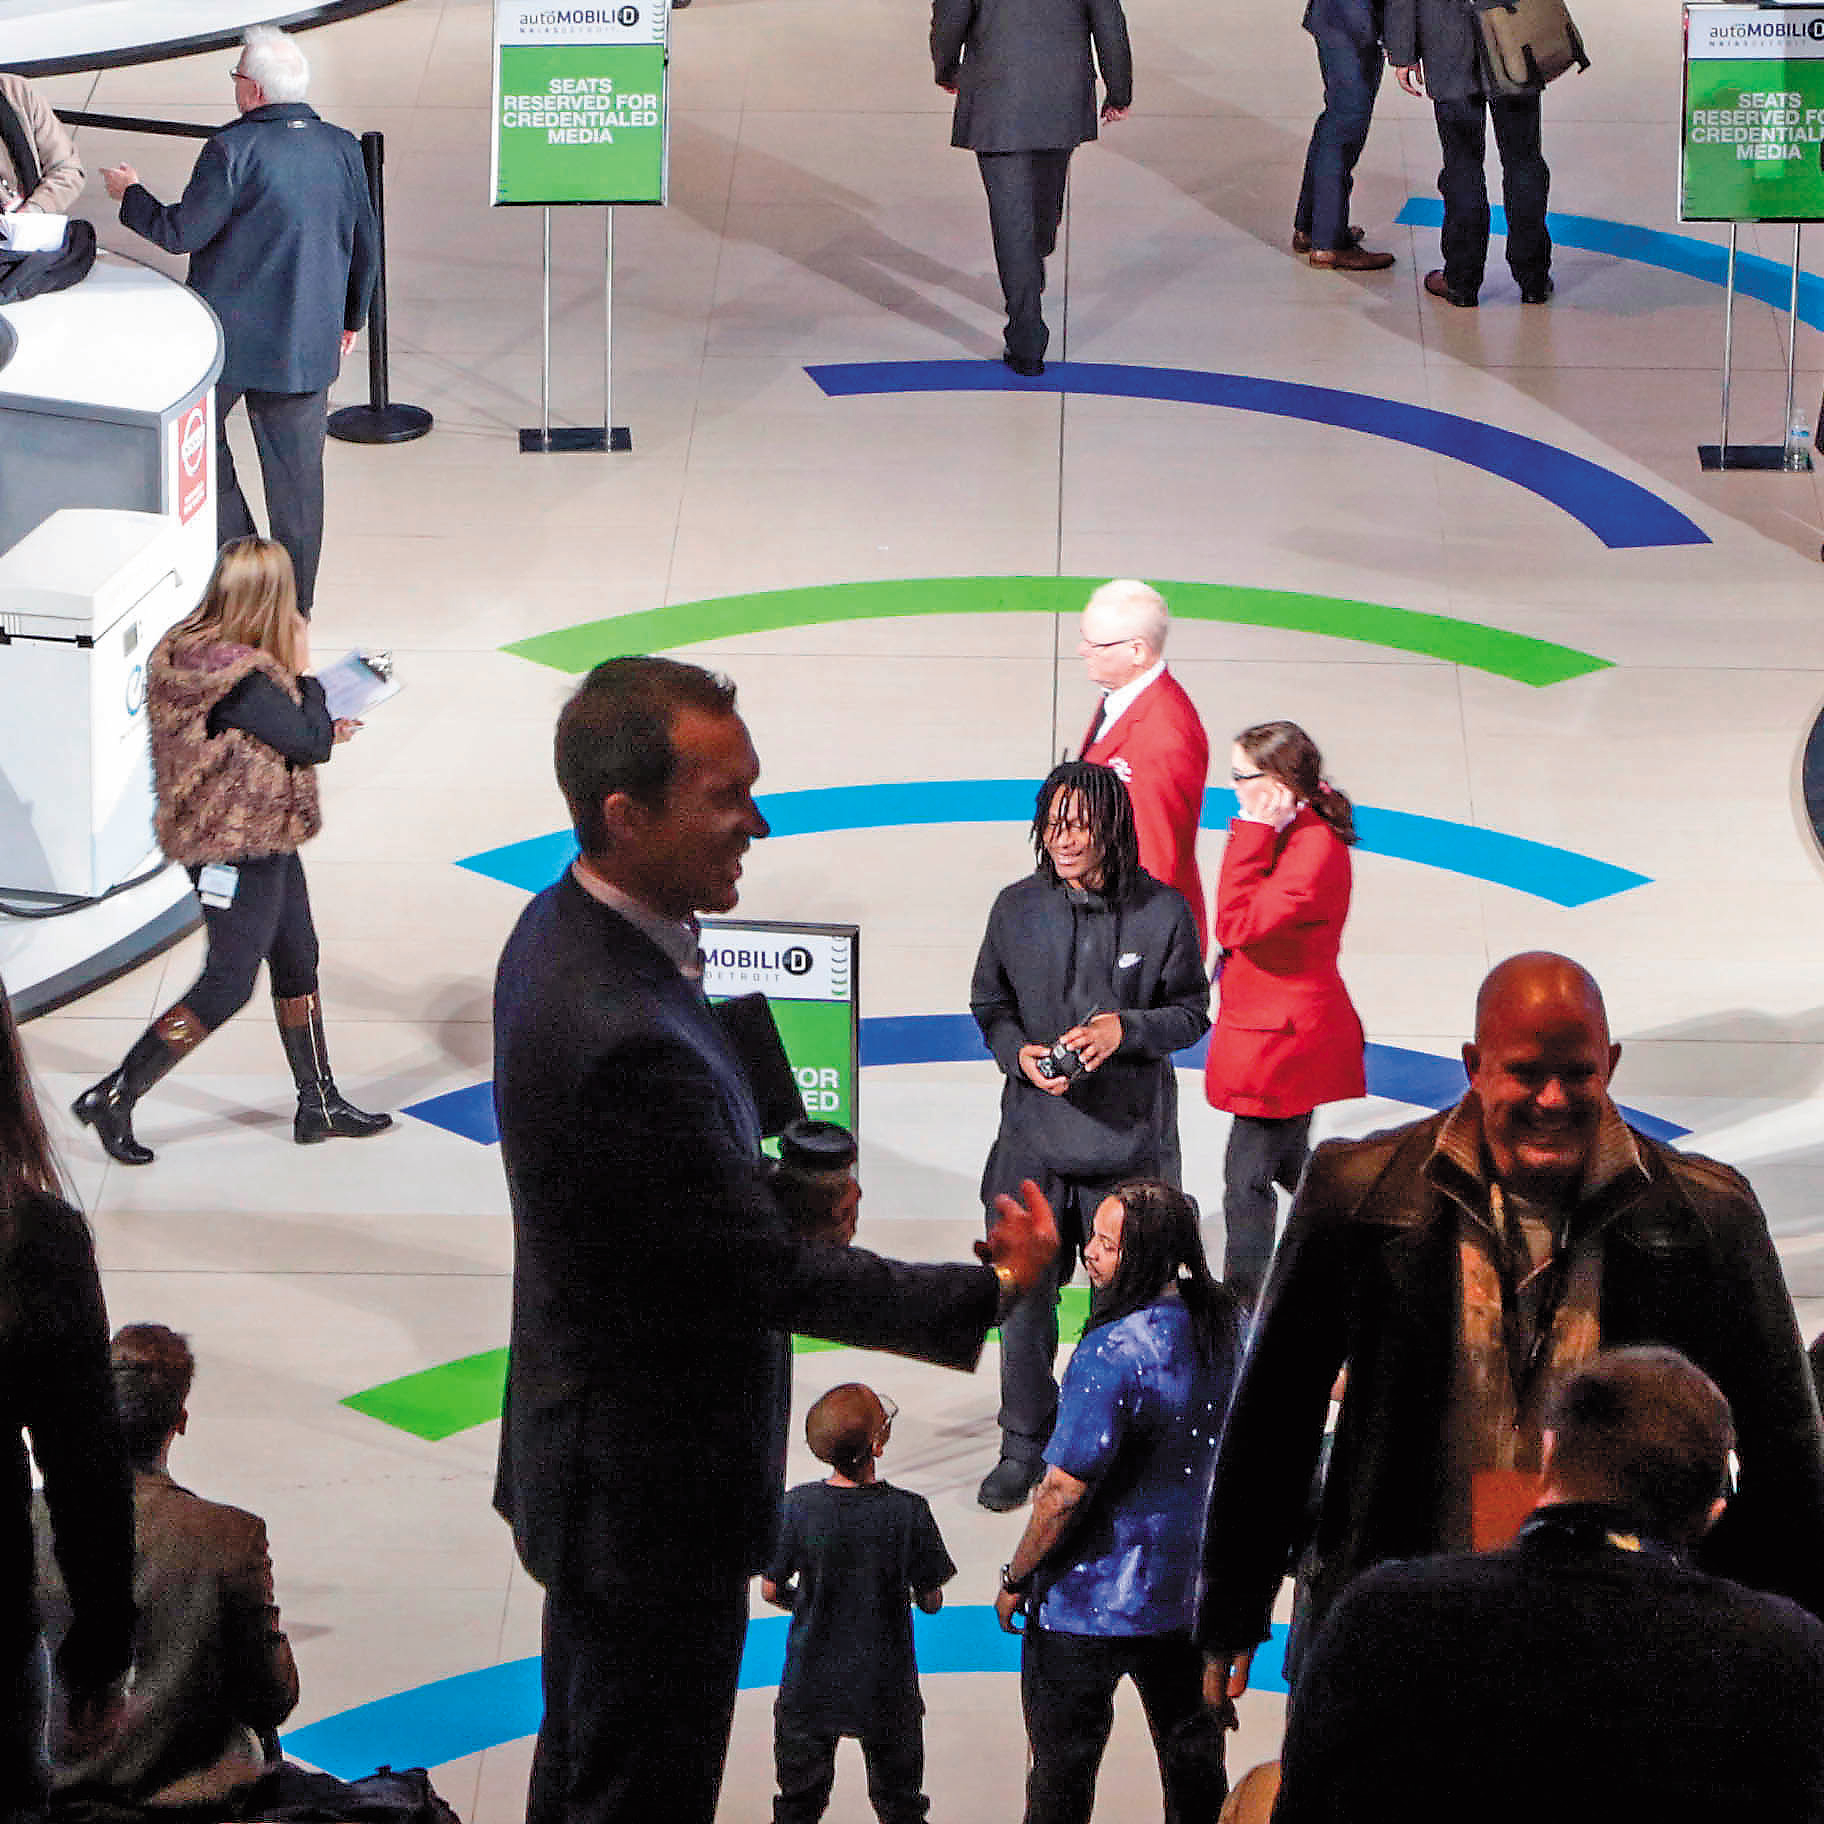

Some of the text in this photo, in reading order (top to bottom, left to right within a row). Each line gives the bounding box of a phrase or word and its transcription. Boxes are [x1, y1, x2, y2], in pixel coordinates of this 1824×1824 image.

[550, 78, 613, 94] SEATS
[503, 94, 657, 110] RESERVED FOR
[1738, 92, 1801, 109] SEATS
[503, 111, 658, 128] CREDENTIALED
[1693, 109, 1800, 126] RESERVED
[548, 128, 614, 145] MEDIA
[1736, 144, 1802, 161] MEDIA
[703, 946, 813, 975] MOBILID
[792, 1067, 840, 1088] OR
